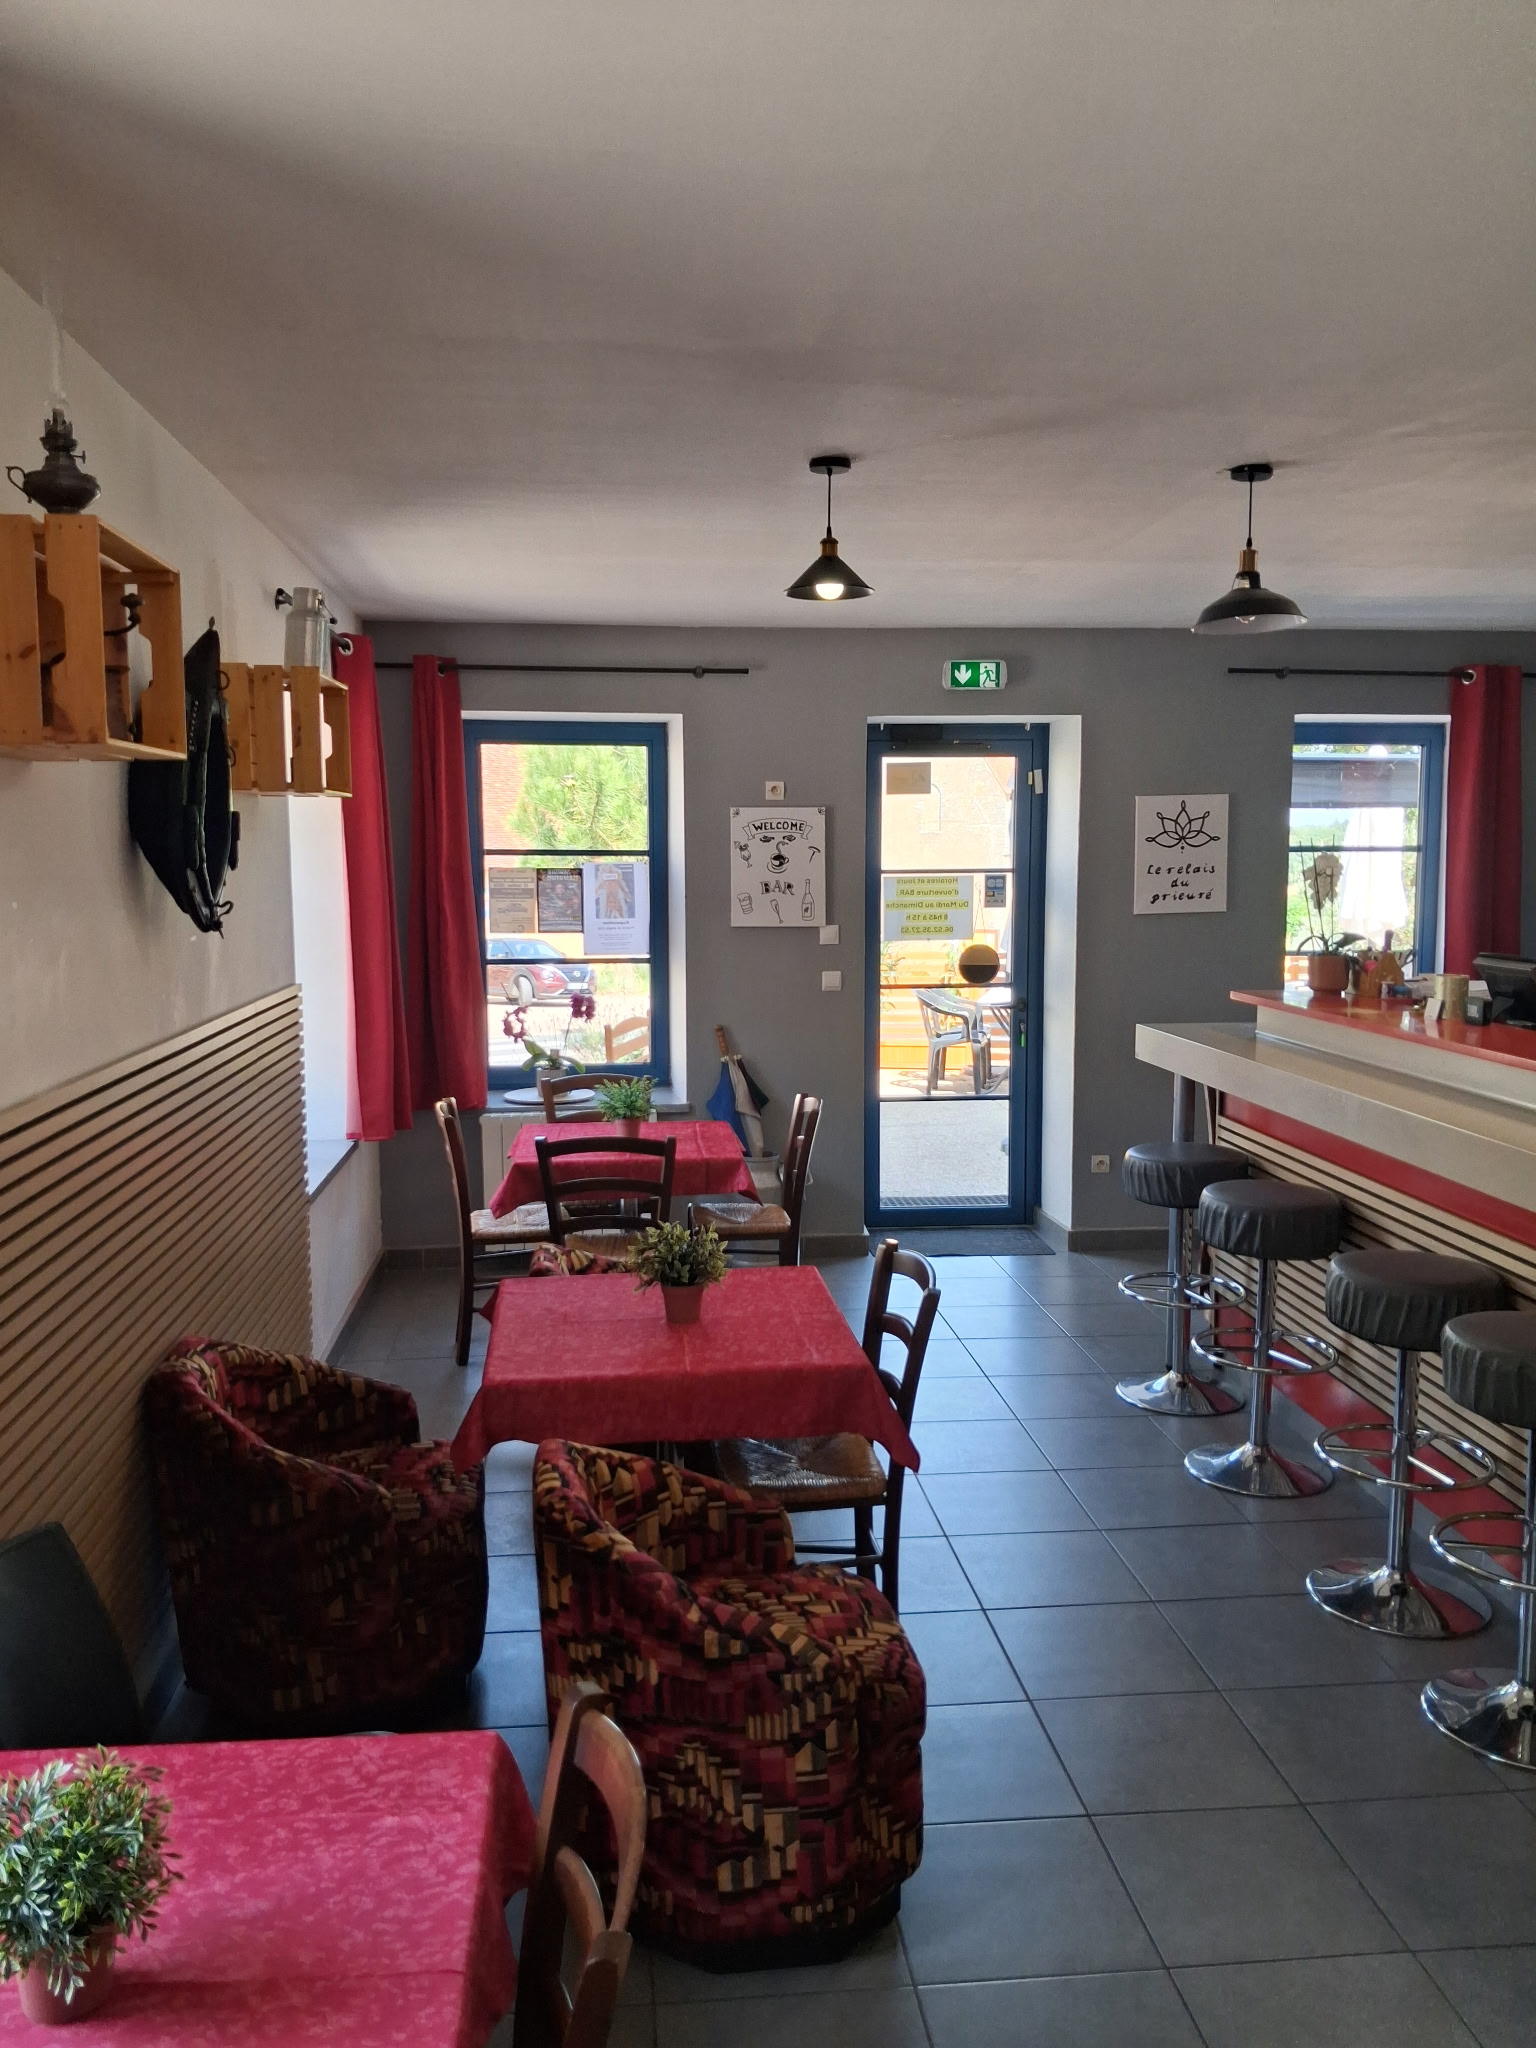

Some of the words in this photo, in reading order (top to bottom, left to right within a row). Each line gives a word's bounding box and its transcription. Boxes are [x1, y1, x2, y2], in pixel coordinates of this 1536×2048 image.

[752, 820, 805, 832] WELCOME
[1147, 864, 1162, 875] Le
[1165, 863, 1216, 875] relais
[760, 879, 795, 896] BAR
[1171, 878, 1189, 888] du
[1150, 888, 1214, 904] prieuré
